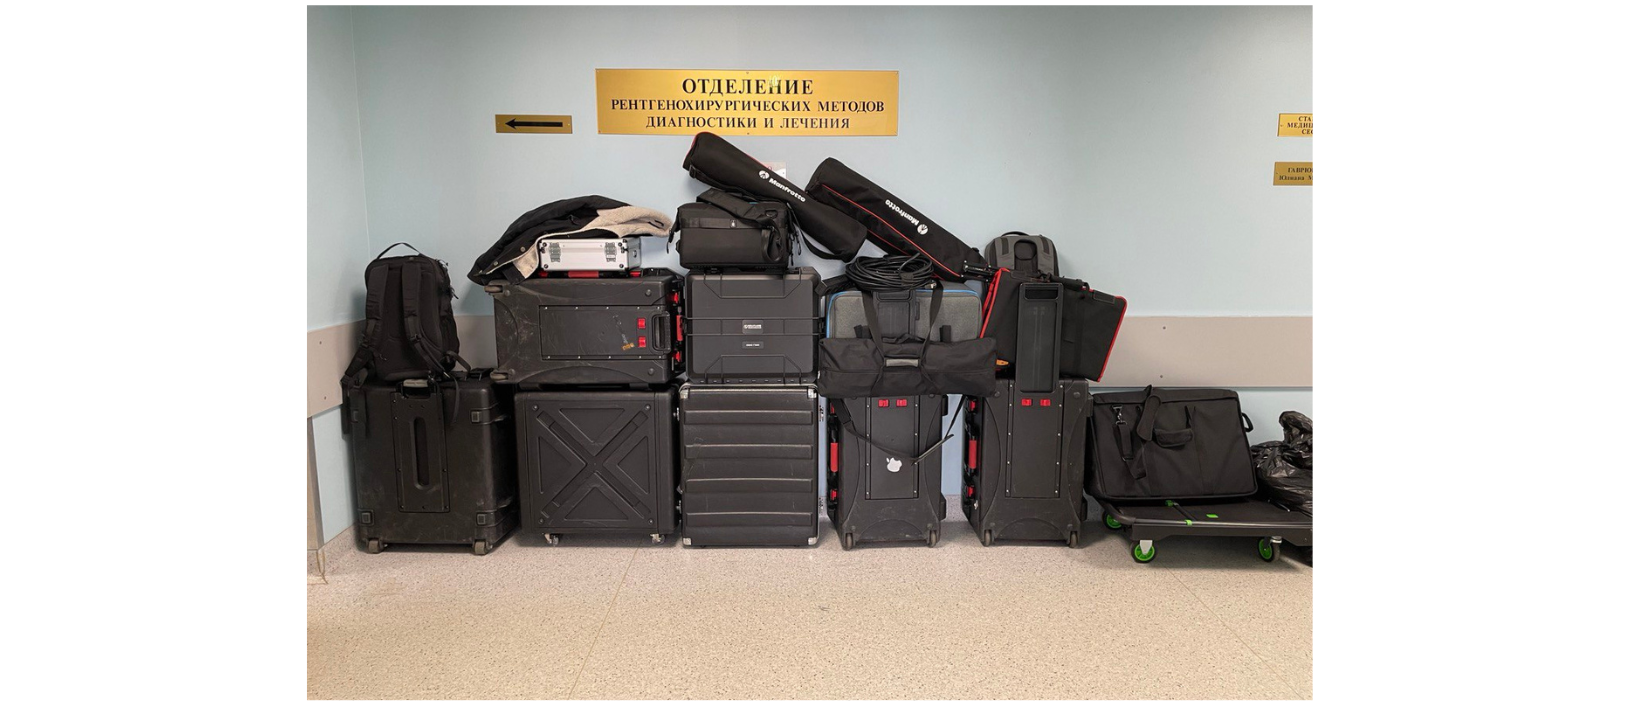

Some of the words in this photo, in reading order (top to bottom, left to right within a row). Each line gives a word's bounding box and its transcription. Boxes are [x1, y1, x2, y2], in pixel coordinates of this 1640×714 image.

[682, 78, 814, 96] ОТДЕЛЕНИЕ
[611, 99, 811, 112] РЕНТГЕНОХИРУРГИЧЕСКИХ
[817, 100, 885, 113] МЕТОДОВ
[645, 116, 757, 129] ДИАГНОСТИКИ
[764, 117, 774, 128] И
[780, 117, 850, 129] ЛЕЧЕНИЯ
[769, 178, 806, 202] Manfrotto
[885, 199, 920, 226] Manfrotto
